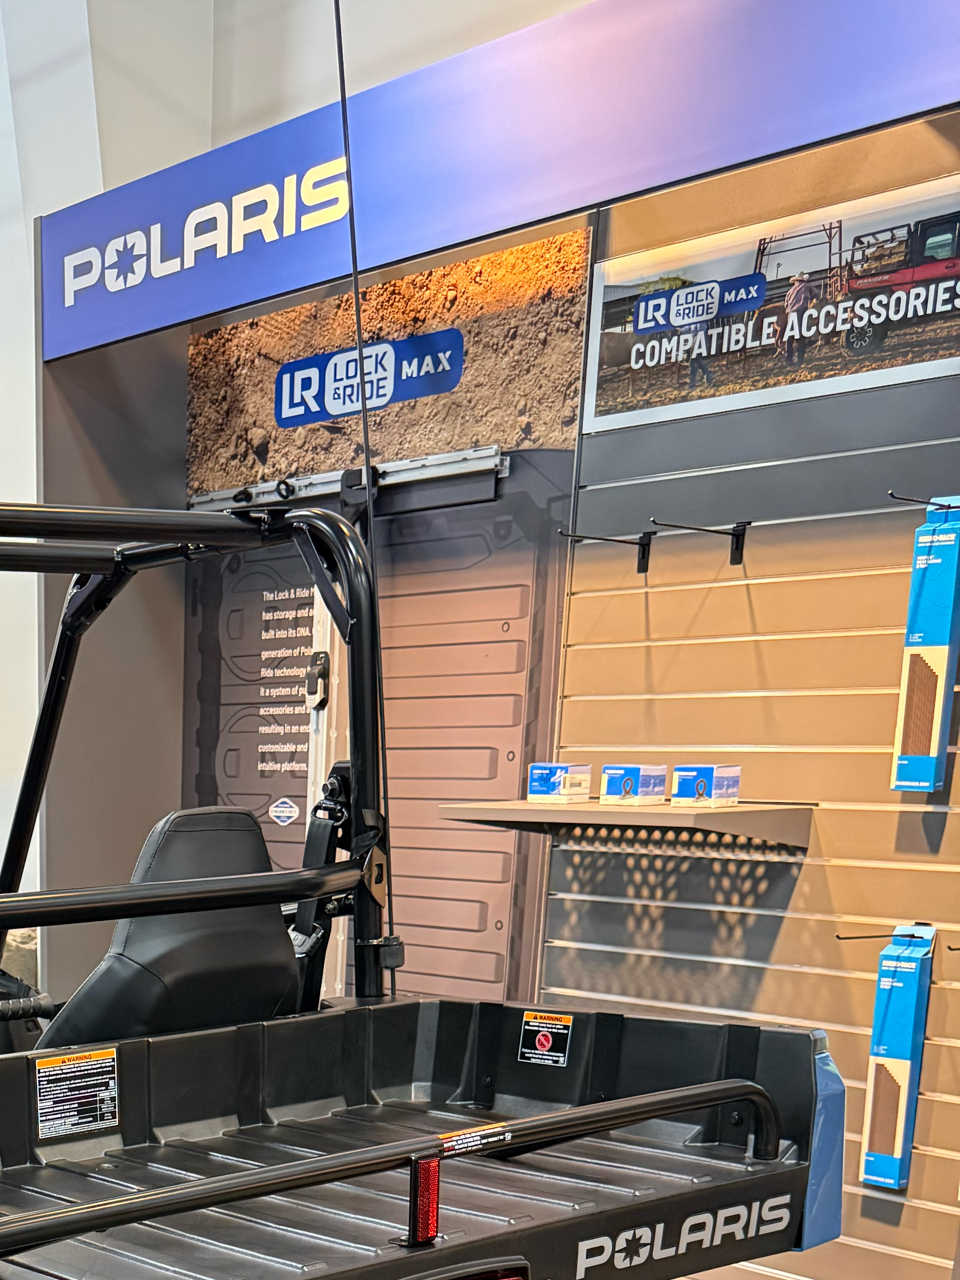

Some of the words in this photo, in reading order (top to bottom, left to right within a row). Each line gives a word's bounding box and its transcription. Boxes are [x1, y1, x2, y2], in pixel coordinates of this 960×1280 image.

[64, 156, 350, 308] POLARIS
[675, 282, 715, 307] LOCK
[723, 285, 759, 305] MAX
[630, 315, 779, 371] COMPATIBLE
[332, 351, 389, 383] LOCK
[401, 350, 452, 380] MAX
[262, 591, 274, 601] The
[274, 589, 289, 601] Lock
[289, 588, 295, 599] &
[295, 587, 309, 598] Ride
[261, 611, 273, 621] has
[273, 609, 296, 621] storage
[296, 607, 308, 617] and
[261, 629, 275, 640] built
[275, 627, 287, 638] into
[287, 627, 296, 638] its
[296, 626, 311, 637] DNA.
[260, 648, 293, 661] generation
[292, 646, 300, 657] of
[300, 645, 314, 657] Pola
[260, 667, 274, 678] Ride
[274, 666, 307, 678] technology
[259, 686, 265, 697] it
[265, 688, 270, 697] a
[270, 686, 291, 698] system
[291, 685, 298, 696] of
[259, 704, 293, 715] accessories
[294, 704, 305, 714] and
[258, 724, 284, 736] resulting
[284, 723, 291, 733] in
[291, 724, 299, 733] an
[257, 742, 296, 753] customizable
[296, 742, 308, 752] and
[257, 761, 281, 772] intuitive
[281, 761, 308, 773] platform.
[538, 1014, 563, 1022] WARNING
[67, 1054, 92, 1063] WARNING
[575, 1193, 791, 1280] POLARIS
